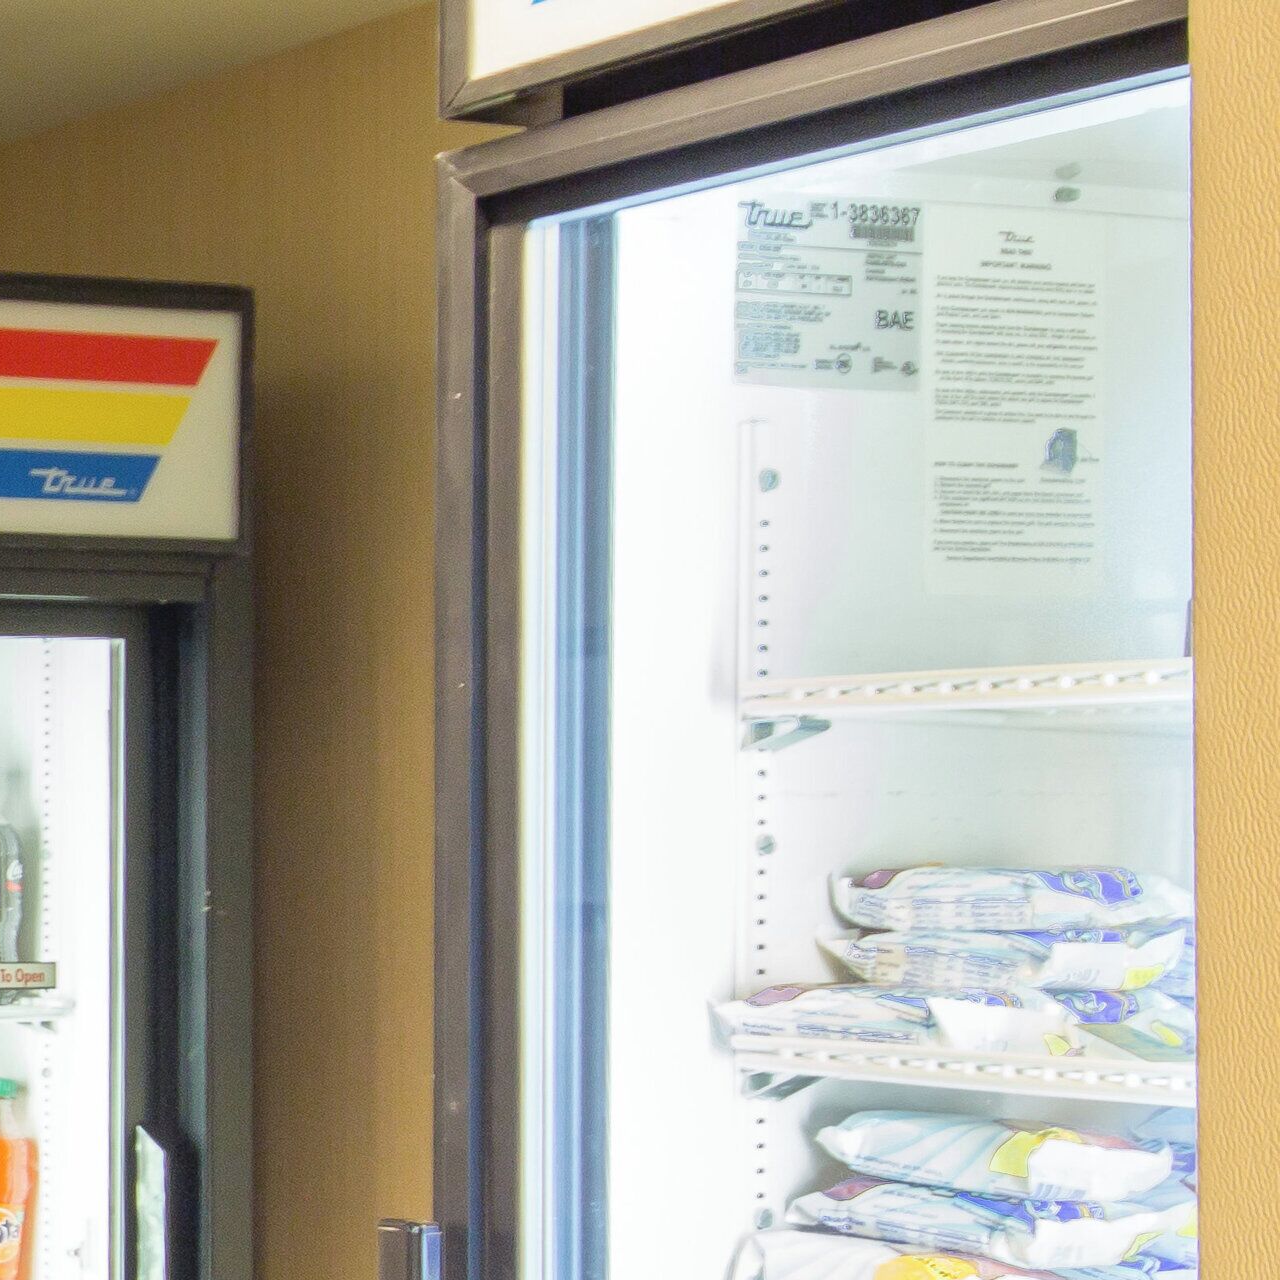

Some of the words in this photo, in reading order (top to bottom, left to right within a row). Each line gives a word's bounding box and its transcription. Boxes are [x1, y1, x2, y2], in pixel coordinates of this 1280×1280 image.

[875, 309, 915, 330] BAE
[0, 969, 13, 983] To
[15, 969, 46, 985] Open
